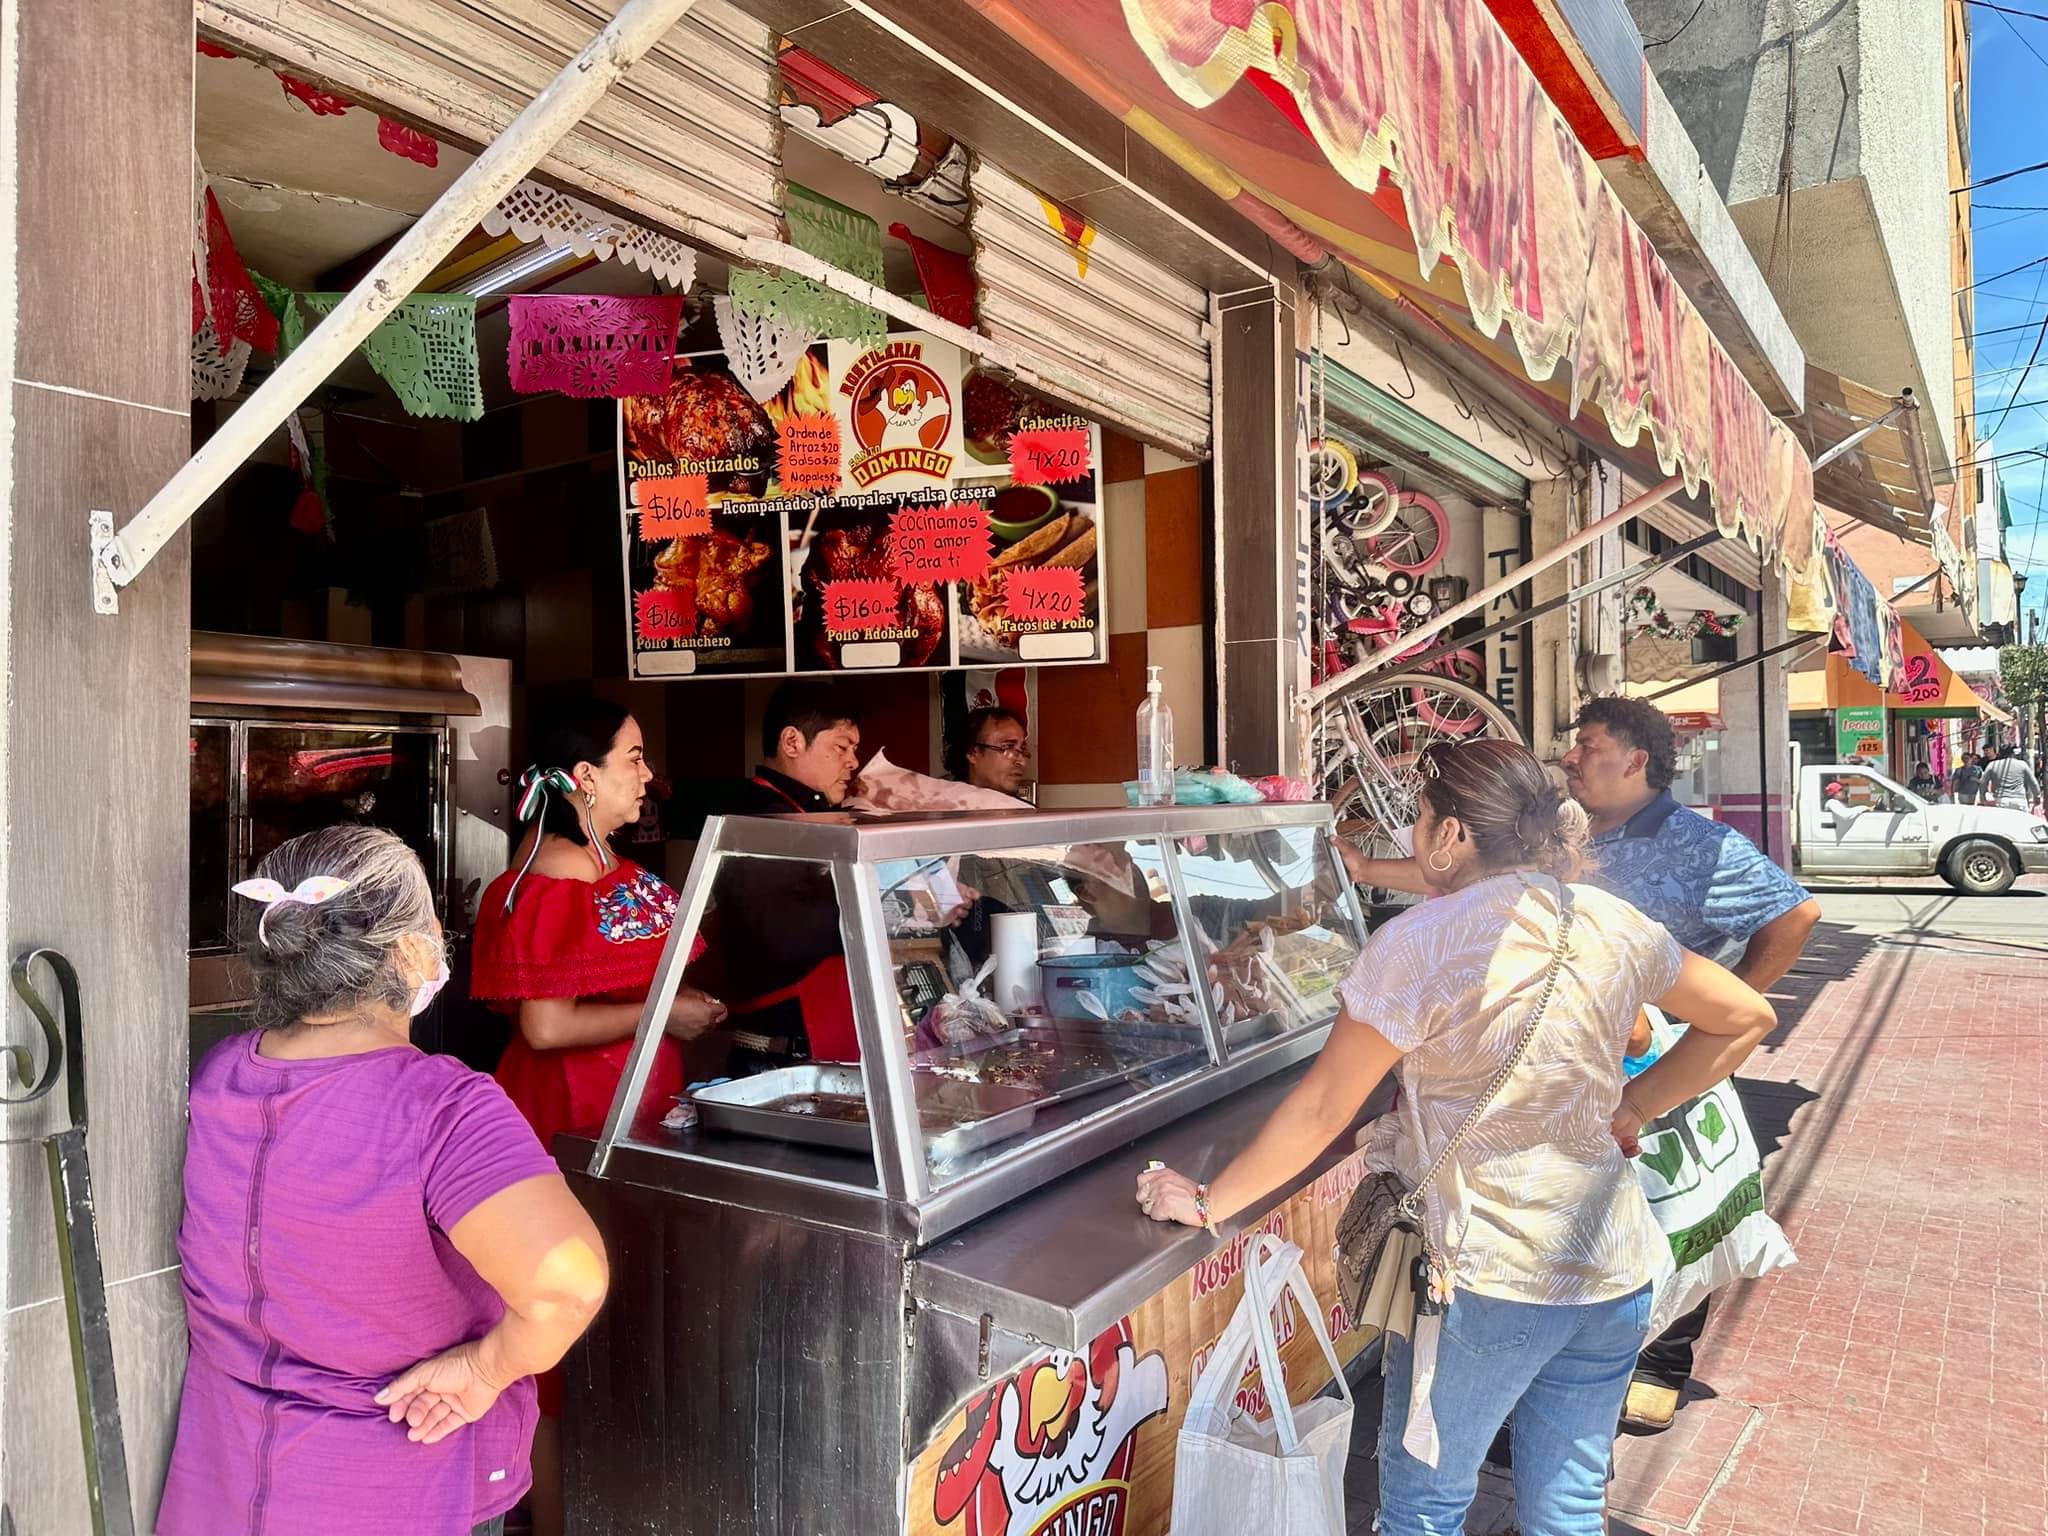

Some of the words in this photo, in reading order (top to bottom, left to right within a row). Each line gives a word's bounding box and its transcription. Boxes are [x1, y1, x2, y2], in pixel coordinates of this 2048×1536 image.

[1020, 413, 1088, 430] Cabecitas
[848, 445, 880, 467] SANTO
[628, 460, 673, 478] Pollos
[679, 456, 760, 474] Rostizados
[853, 451, 949, 485] DOMINGO
[722, 498, 815, 516] Acompañados
[820, 497, 835, 509] de
[841, 494, 893, 511] nopales
[899, 494, 906, 506] y
[911, 489, 945, 503] salsa
[951, 486, 995, 501] casera
[1295, 348, 1311, 657] TALLER
[934, 536, 971, 548] amor
[899, 551, 941, 570] Para
[948, 552, 960, 567] ti
[828, 629, 859, 641] Pollo
[864, 626, 919, 640] Adobado
[1001, 620, 1038, 632] Tacos
[1042, 619, 1057, 630] de
[1062, 617, 1094, 630] Pollo
[672, 635, 731, 649] Ranchero
[1912, 688, 1940, 702] 200
[1191, 1211, 1284, 1302] Rostido
